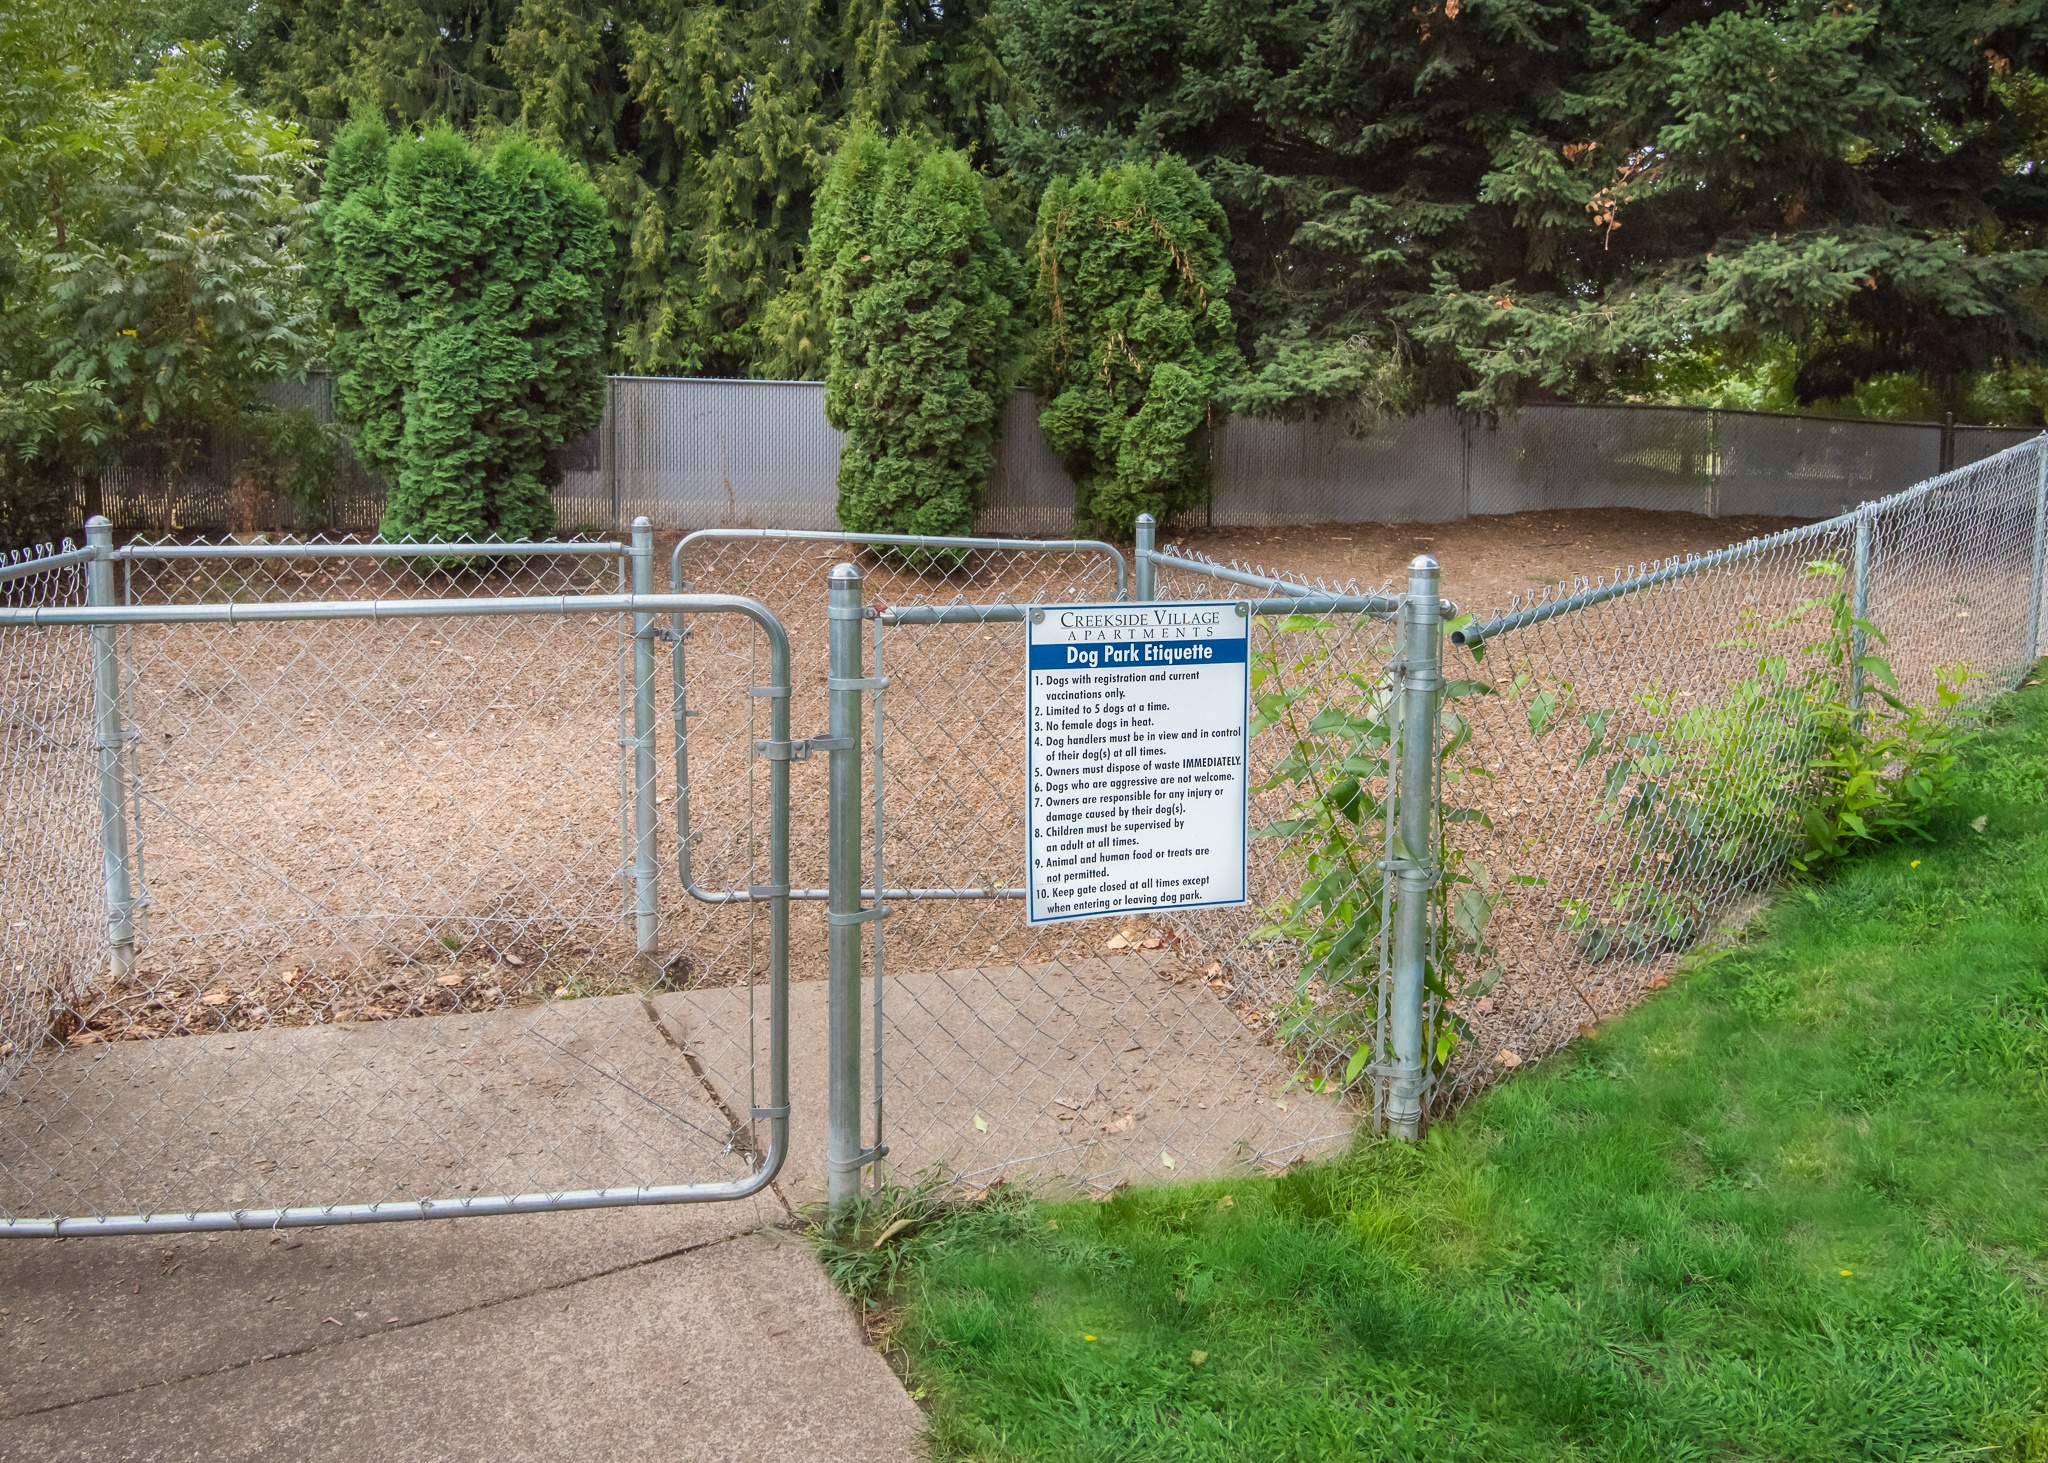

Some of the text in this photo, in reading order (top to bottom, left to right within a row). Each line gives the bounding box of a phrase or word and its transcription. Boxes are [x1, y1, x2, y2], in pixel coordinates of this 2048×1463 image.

[1060, 609, 1220, 628] CREEKSIDE VILLAGE
[1067, 626, 1214, 641] APARTMENTS
[1067, 644, 1213, 668] Dog Park Etiquette
[1035, 671, 1200, 688] 1. Dogs with registration and current
[1046, 688, 1126, 701] vaccinations only.
[1034, 701, 1170, 717] 2. Limited to 5 dogs at a time.
[1034, 717, 1154, 732] 3. No female dogs in heat.
[1034, 727, 1241, 748] 4. Dog handlers must be in view and in control
[1046, 745, 1167, 762] of their dog(s) at all times.
[1034, 756, 1242, 777] 5. Owners must dispose of waste IMMEDIATELY.
[1034, 772, 1235, 794] 6. Dogs who are aggressive are not welcome.
[1034, 787, 1224, 808] 7. Owners are responsible for any injury or
[1046, 803, 1186, 823] damage caused by their dog(s).
[1034, 818, 1185, 838] 8. Children must be supervised by
[1046, 835, 1140, 853] an adult at all times.
[1035, 847, 1210, 869] 9. Animal and human food or treats are
[1046, 867, 1110, 884] not permitted.
[1036, 875, 1210, 900] 10. Keep gate closed at all times except
[1047, 889, 1202, 914] when entering or leaving dog park.
